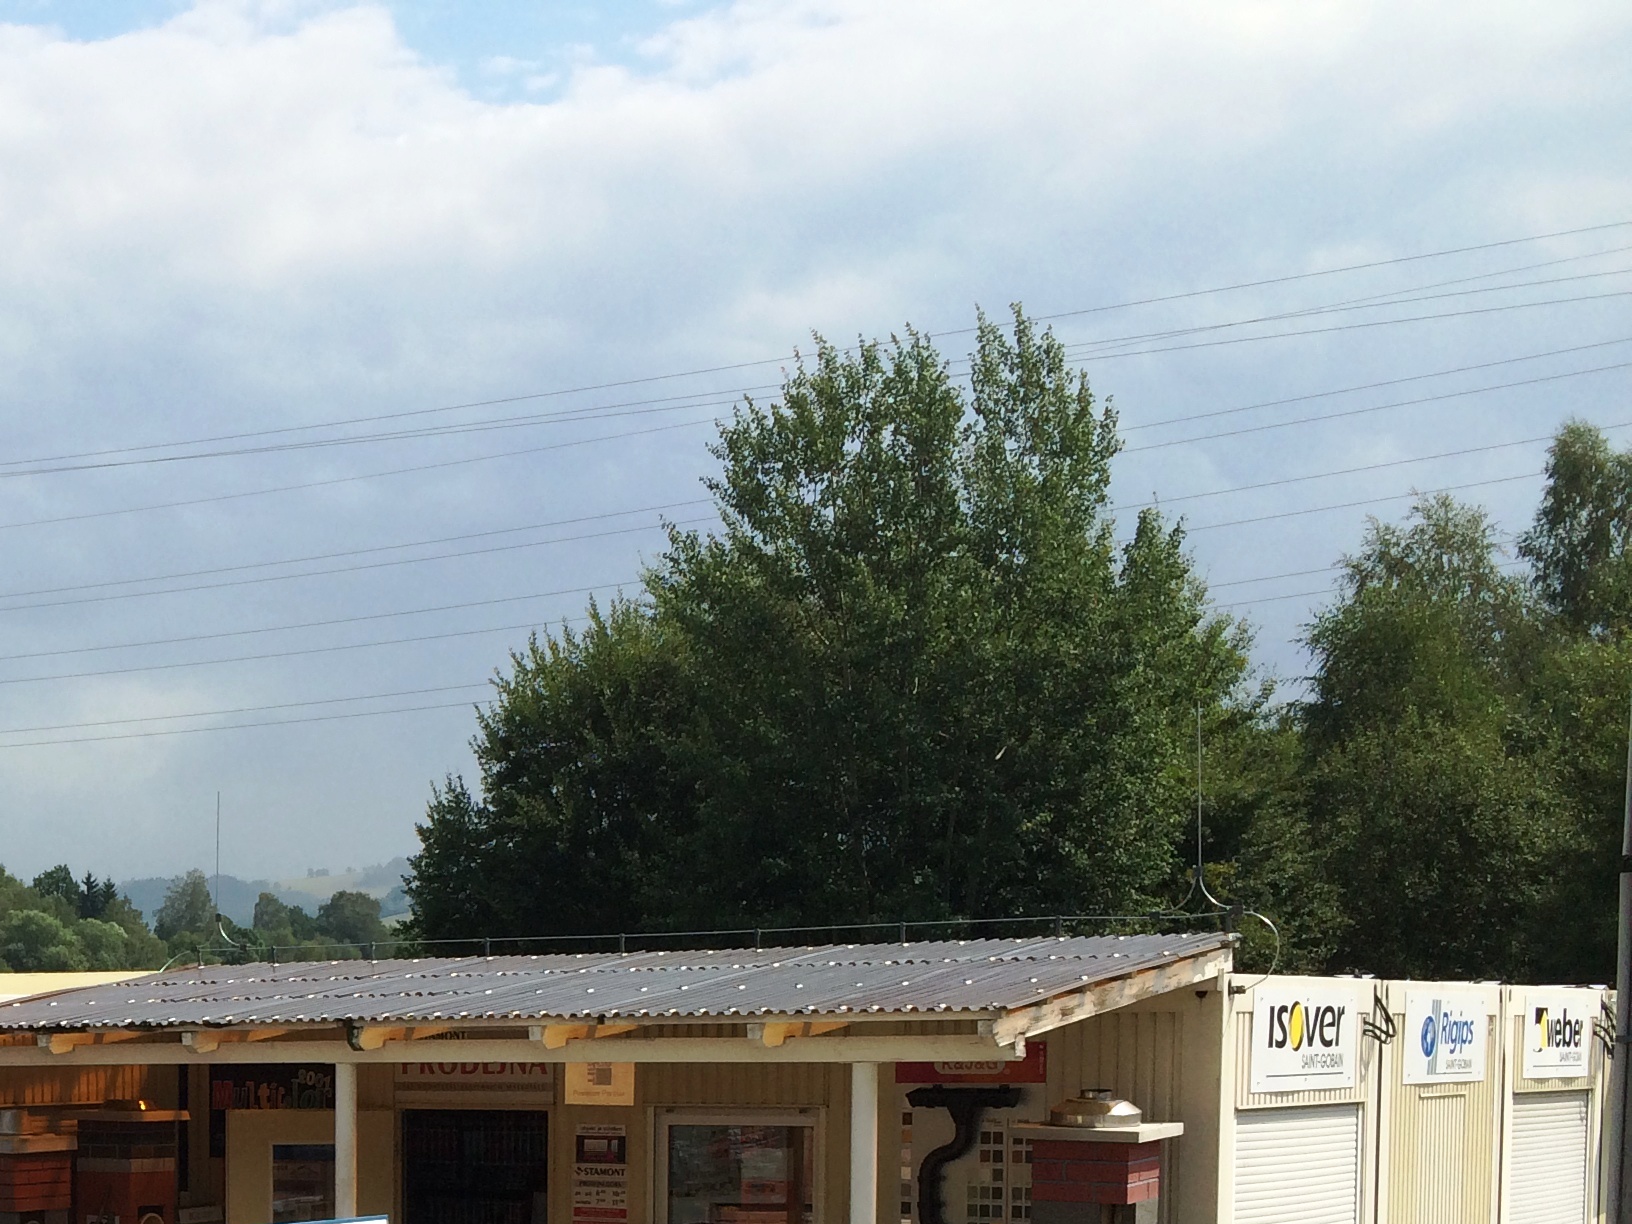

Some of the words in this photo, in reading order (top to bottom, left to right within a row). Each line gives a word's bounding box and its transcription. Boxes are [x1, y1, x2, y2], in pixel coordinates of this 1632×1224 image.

[1440, 1010, 1475, 1054] Rigips
[1546, 1008, 1584, 1048] weber
[1301, 1053, 1344, 1068] SAINT-GOBAIN
[584, 1166, 626, 1177] STAMONT
